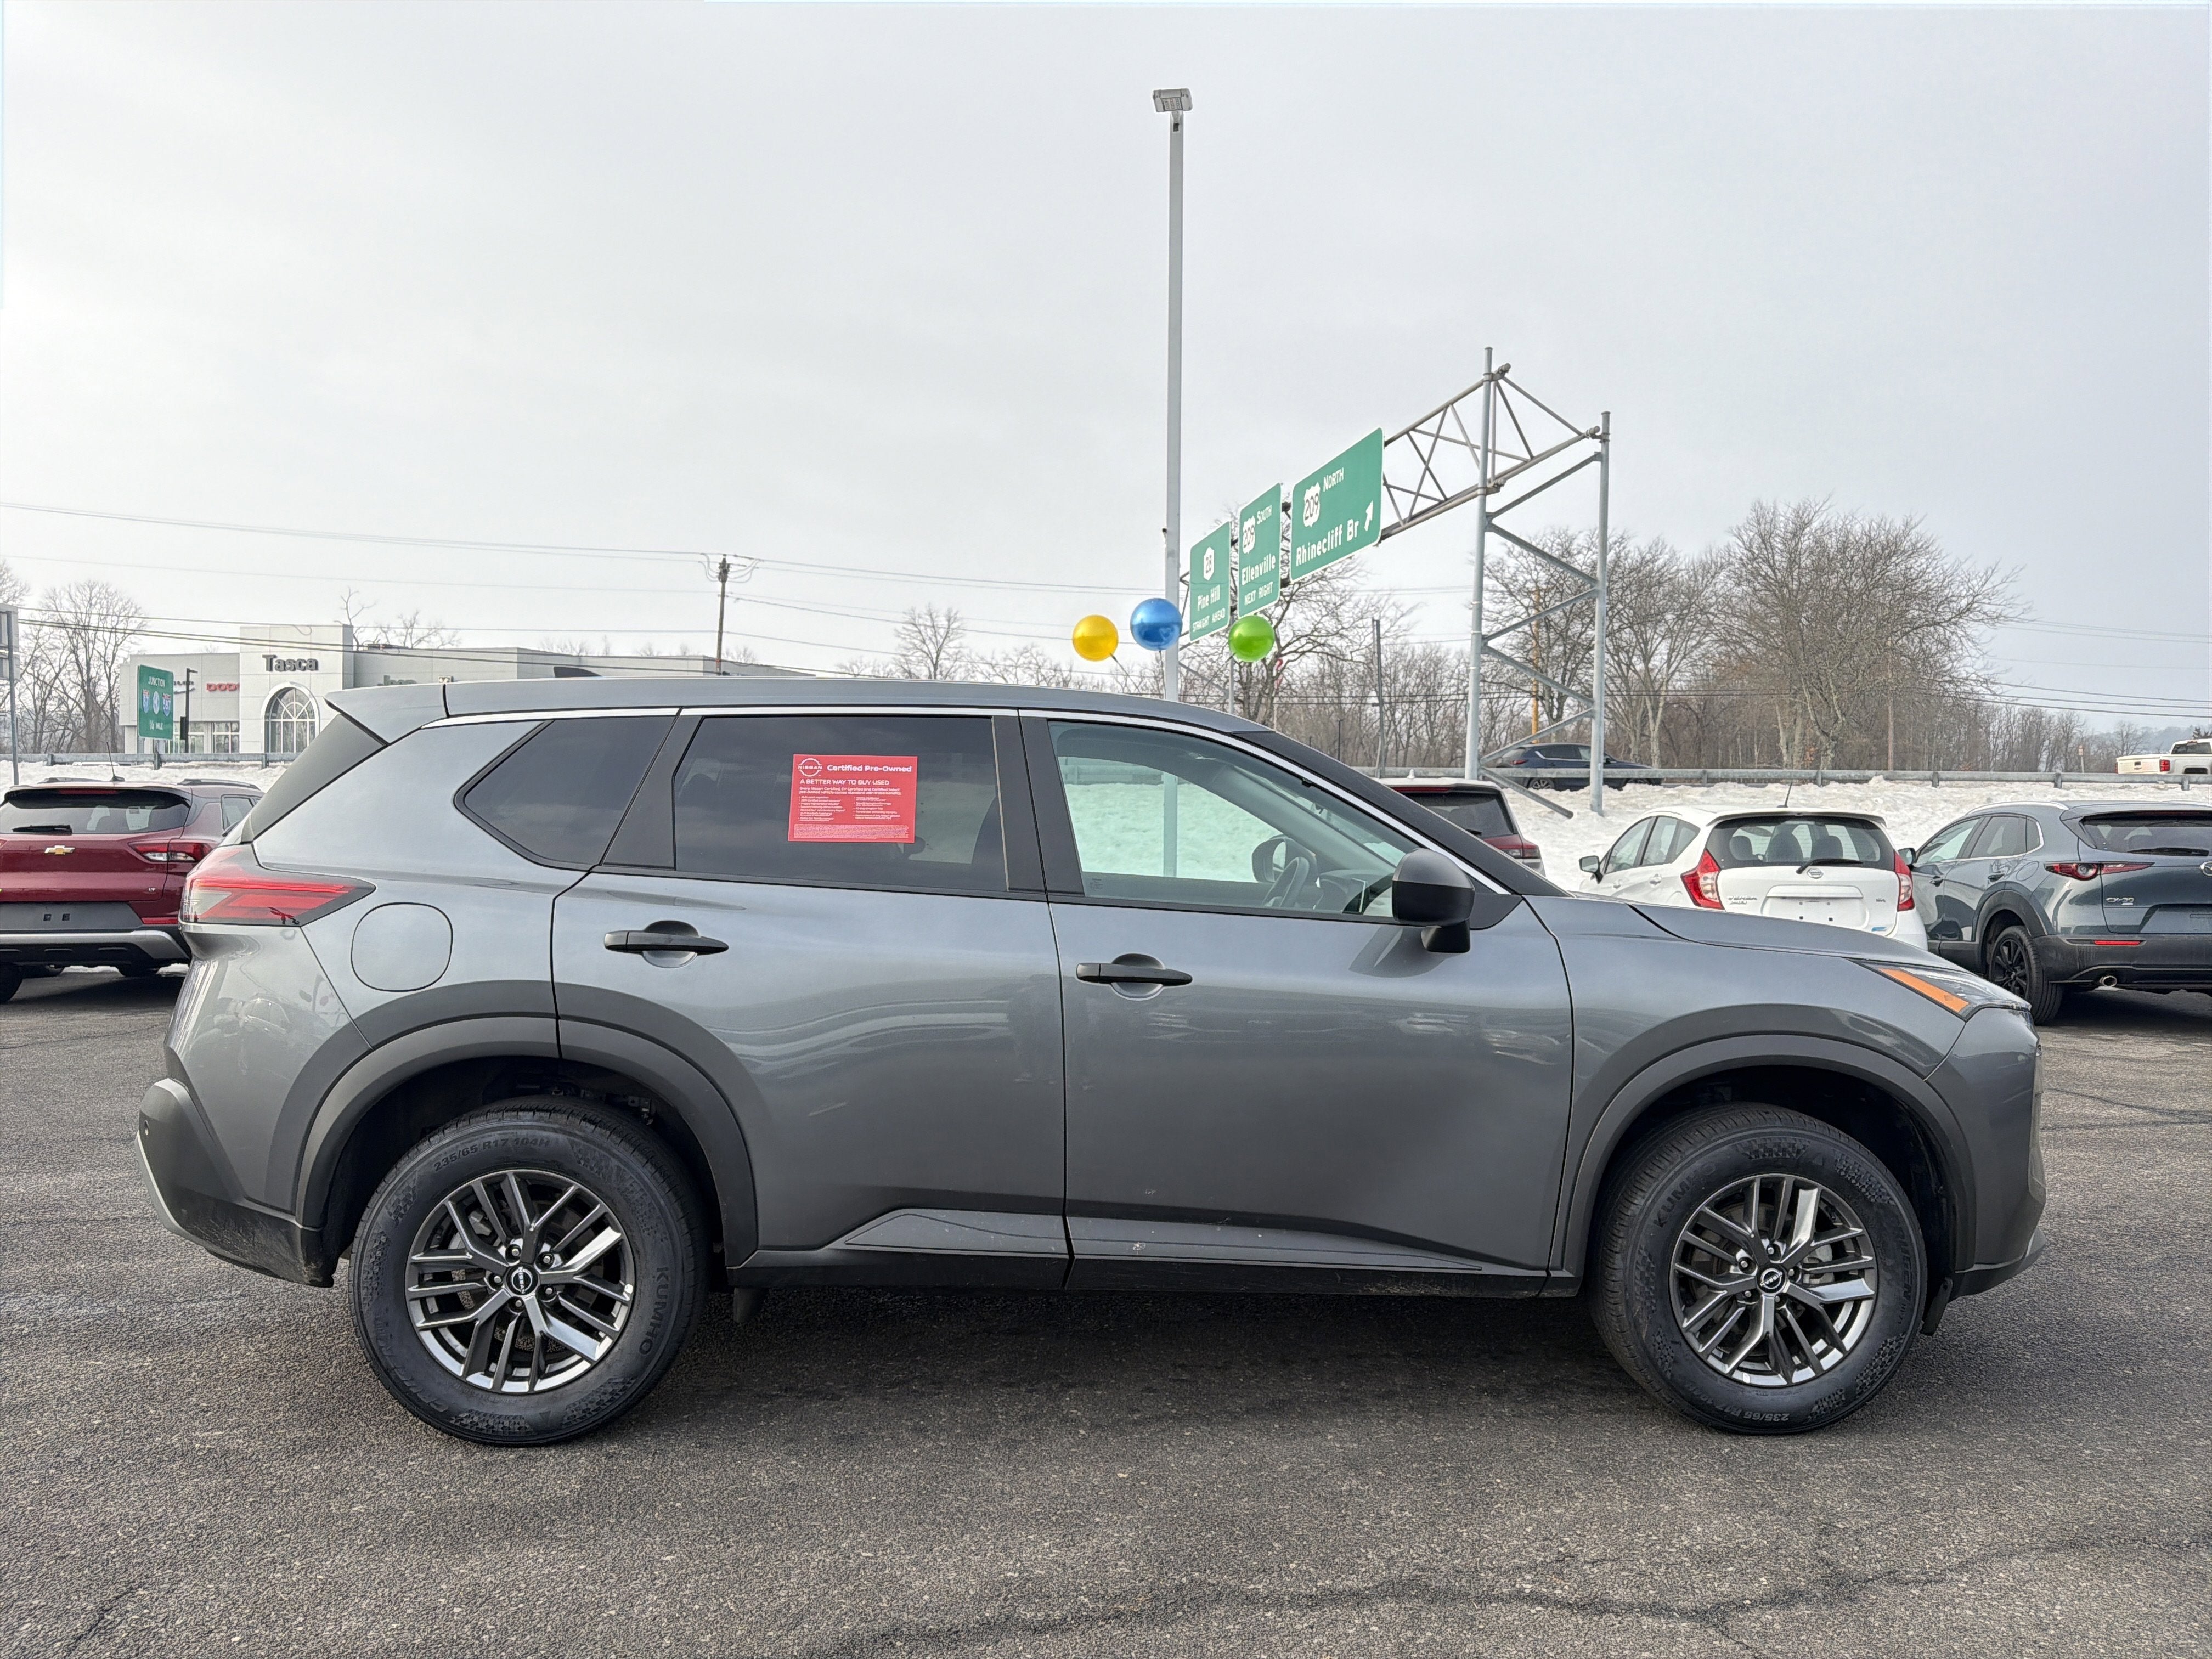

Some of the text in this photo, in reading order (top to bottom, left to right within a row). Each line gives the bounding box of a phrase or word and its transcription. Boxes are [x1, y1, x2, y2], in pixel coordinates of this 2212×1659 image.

[1323, 467, 1344, 492] NORTH
[1305, 493, 1319, 521] 209
[1243, 525, 1255, 548] 209
[1296, 519, 1359, 567] Rhinecliff Br
[1242, 553, 1276, 585] Ellenville
[1210, 584, 1221, 604] Hill
[1244, 582, 1273, 606] NEXT RIGHT
[262, 654, 319, 672] Tasca
[148, 676, 166, 687] JUNCTION
[206, 682, 240, 692] DOD
[433, 1137, 551, 1172] 235/65 R17 104H
[1652, 1161, 1717, 1228] KUMHO
[517, 1266, 526, 1294] NISSAN
[639, 1267, 669, 1355] KUMHO
[1743, 1411, 1790, 1422] 235/65
